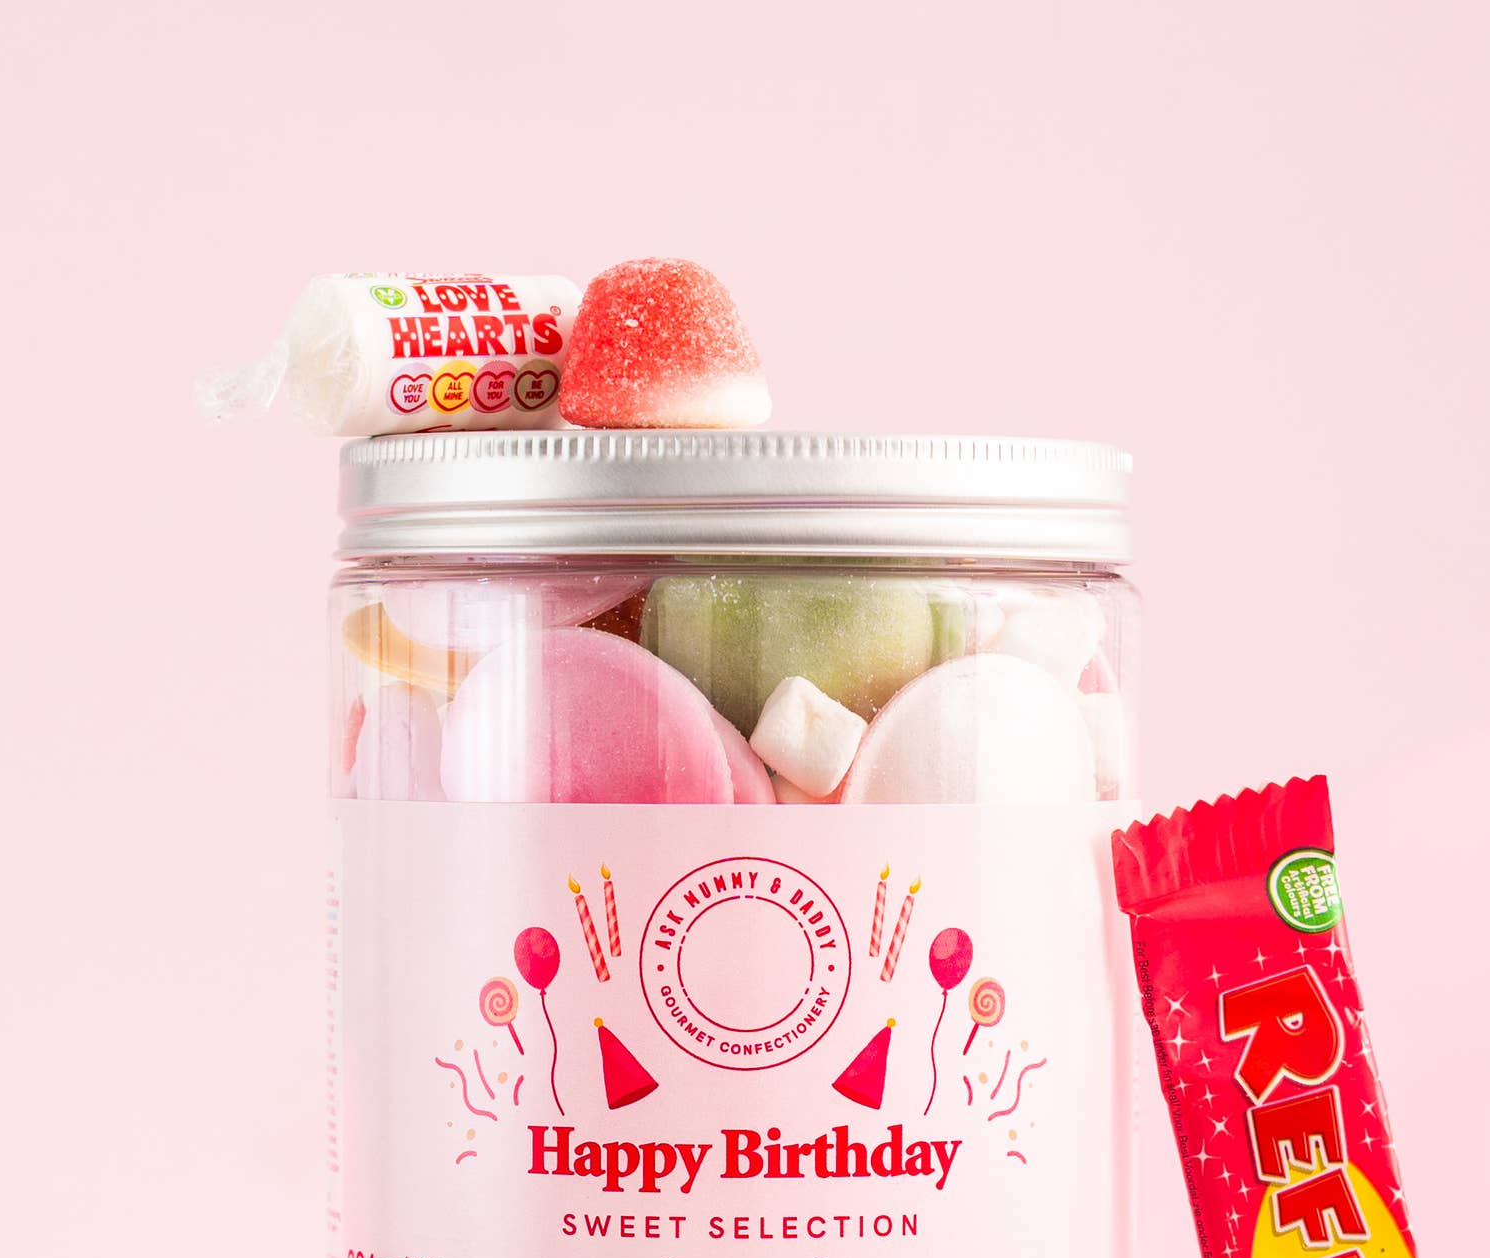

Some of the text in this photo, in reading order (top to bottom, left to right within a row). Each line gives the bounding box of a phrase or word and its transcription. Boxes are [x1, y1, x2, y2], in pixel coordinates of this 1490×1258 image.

[413, 284, 522, 313] LOVE
[387, 313, 563, 359] HEARTS
[403, 382, 424, 394] LOVE
[443, 391, 463, 401] MINE
[447, 382, 462, 391] ALL
[487, 390, 503, 400] YOU
[488, 381, 504, 390] FOR
[525, 390, 545, 400] KIND
[531, 380, 543, 389] BE
[403, 394, 421, 404] YOU
[1281, 876, 1301, 918] Colours
[1289, 870, 1314, 919] Artificial
[1300, 865, 1328, 915] FROM
[1317, 864, 1340, 907] FREE
[654, 871, 837, 950] ASK MUMMY & DADDY
[661, 985, 830, 1055] GOURMET CONFECTIONERY
[527, 1124, 963, 1194] Happy Birthday
[562, 1214, 918, 1239] SWEET SELECTION
